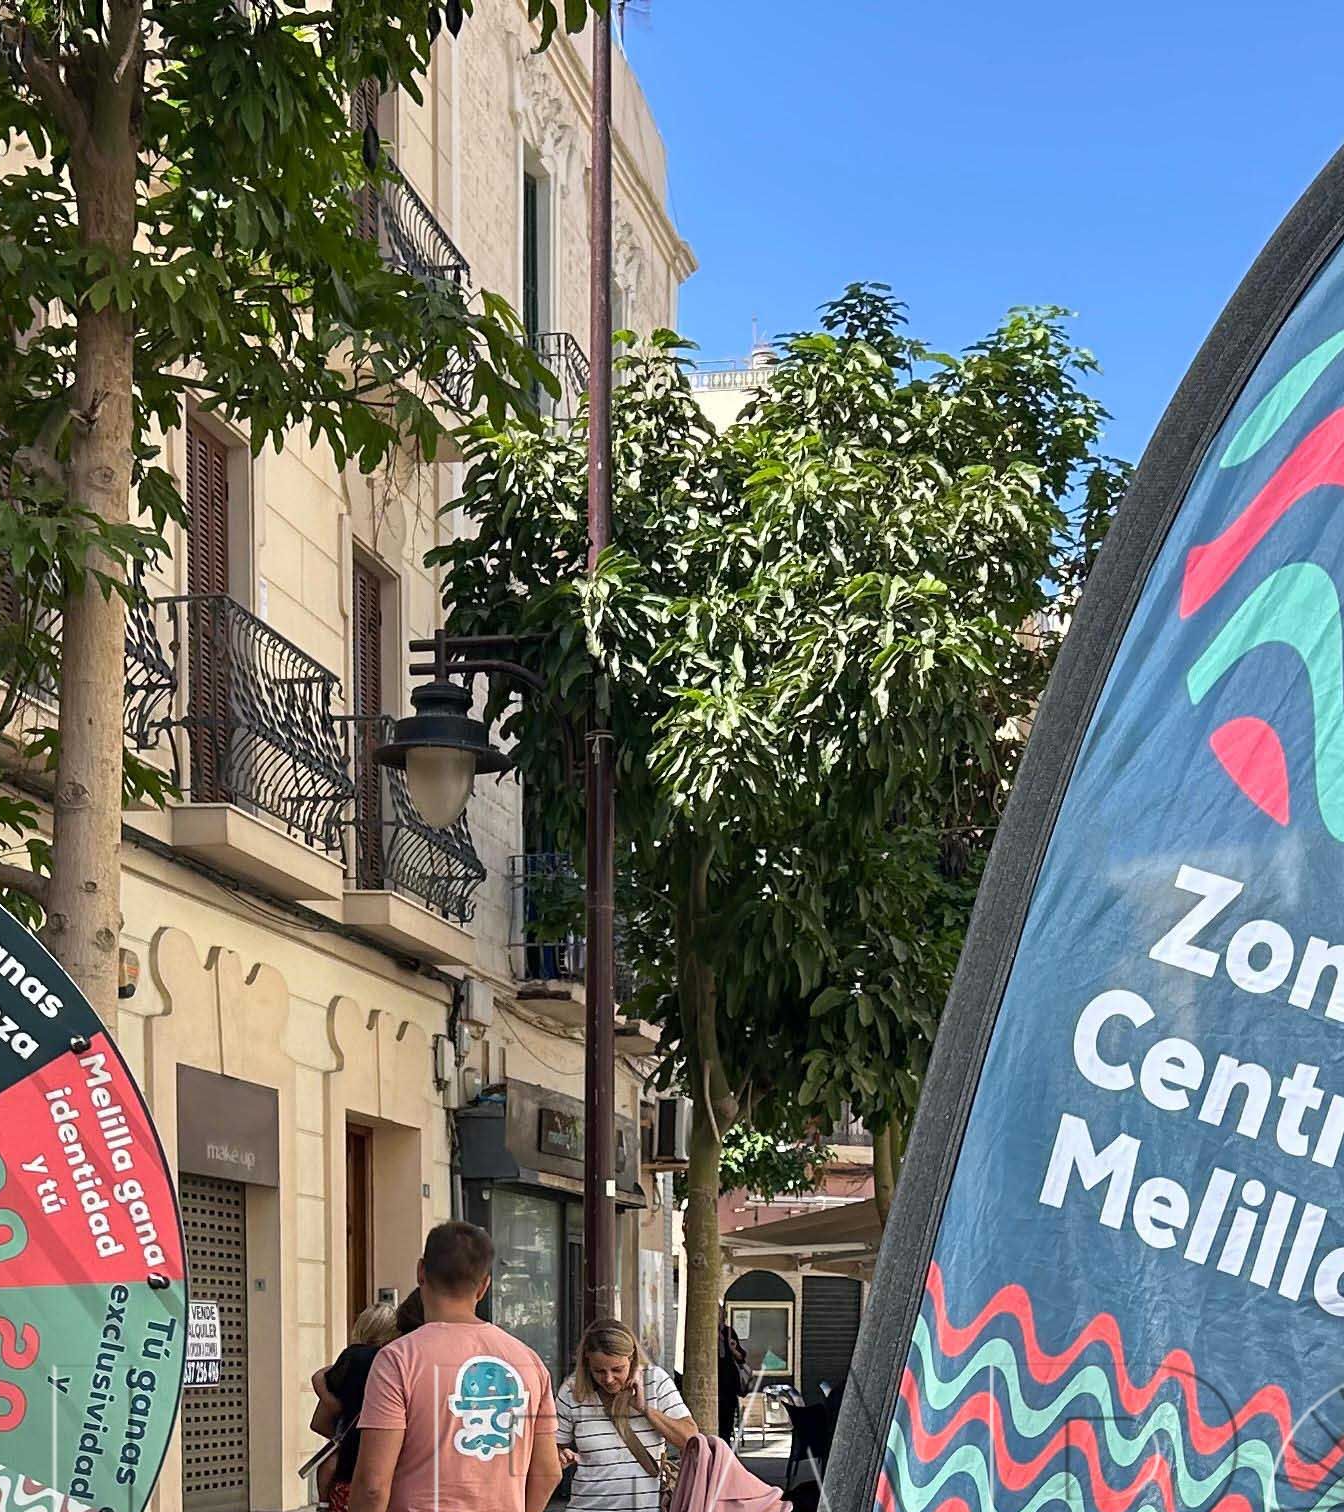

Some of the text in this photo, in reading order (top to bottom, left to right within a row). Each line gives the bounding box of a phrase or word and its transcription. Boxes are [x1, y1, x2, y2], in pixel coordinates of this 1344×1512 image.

[21, 1153, 62, 1215] y tú
[44, 1088, 127, 1258] identidad
[80, 1052, 167, 1269] Melilla gana
[207, 1144, 256, 1170] make up
[47, 1374, 71, 1394] y
[68, 1284, 130, 1500] exclusividad
[116, 1317, 177, 1487] Tú ganas
